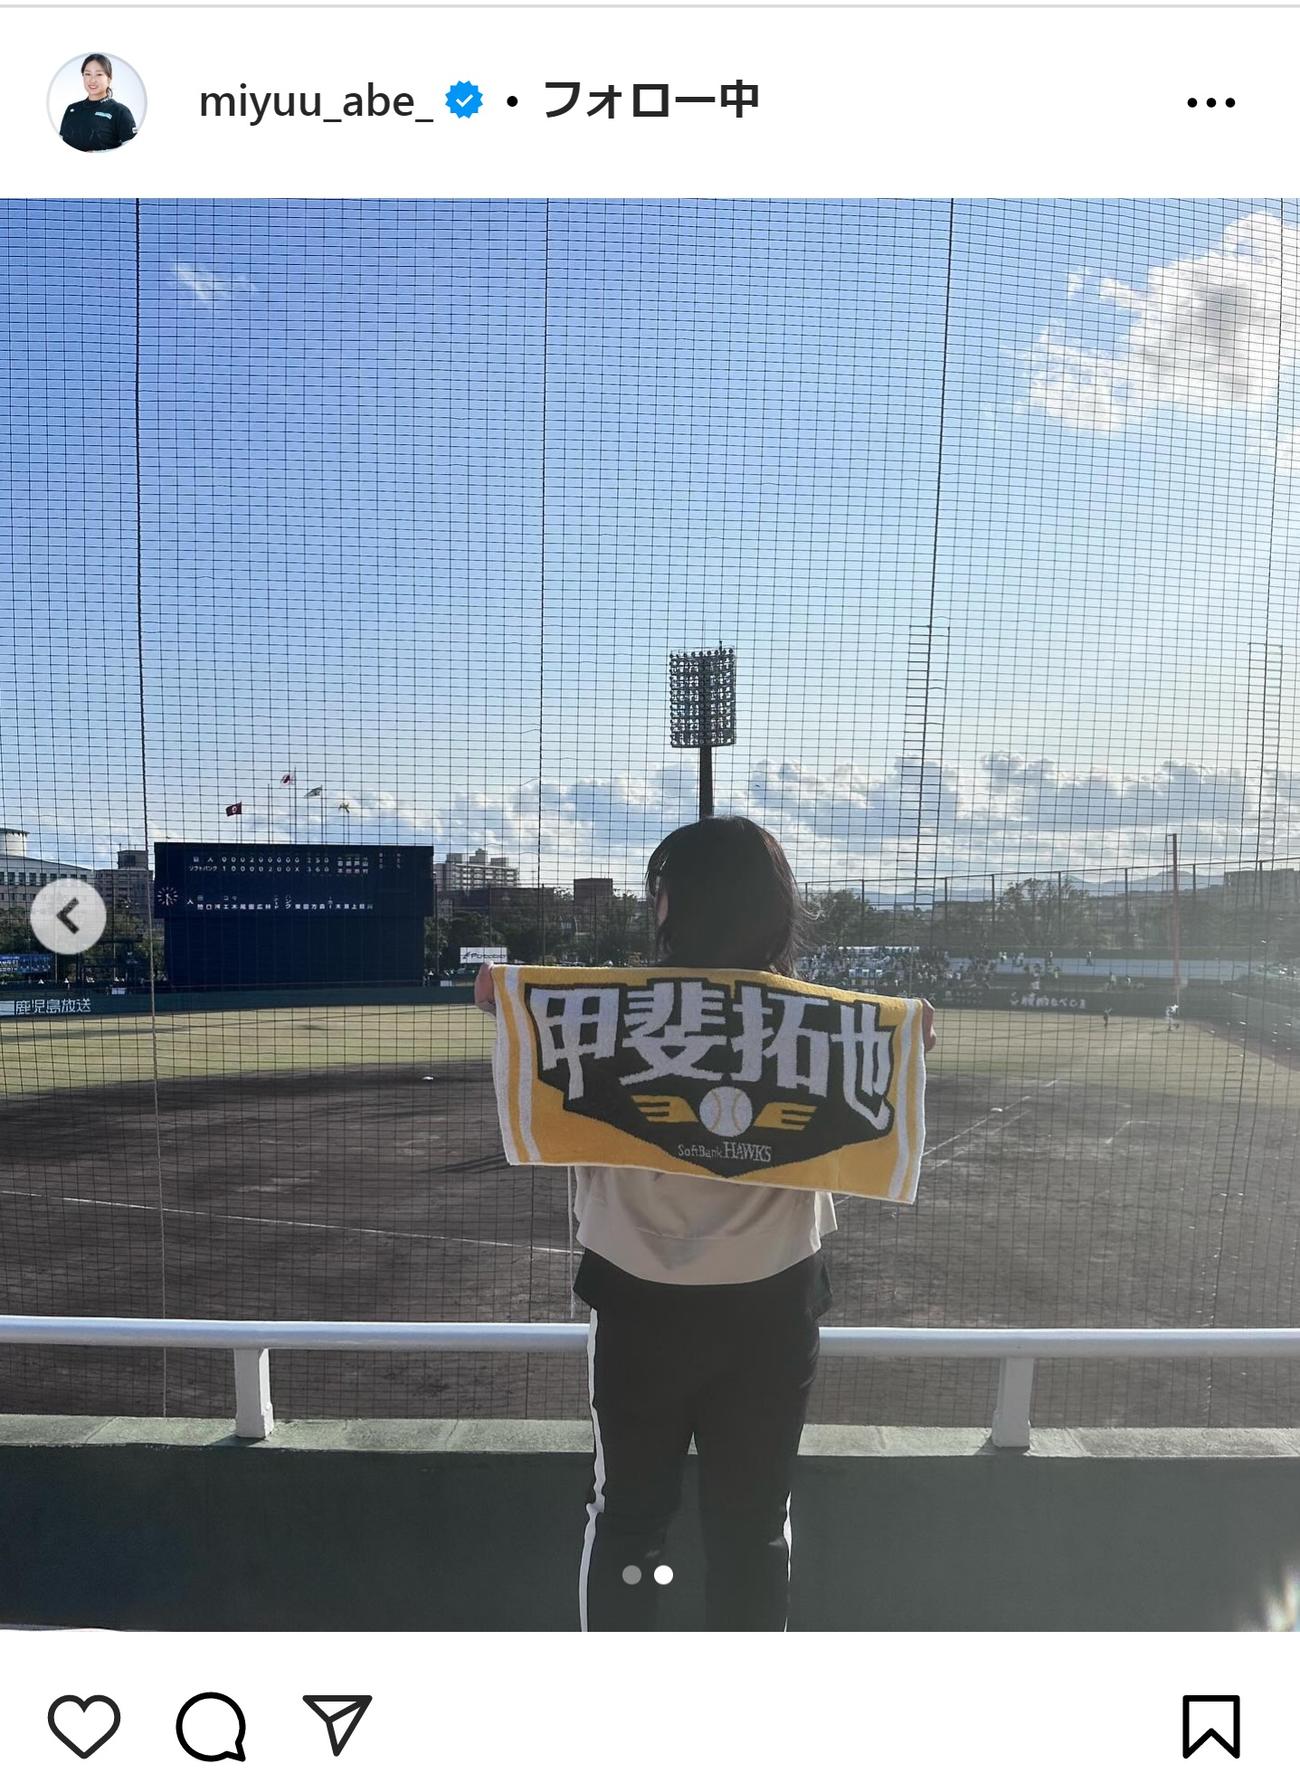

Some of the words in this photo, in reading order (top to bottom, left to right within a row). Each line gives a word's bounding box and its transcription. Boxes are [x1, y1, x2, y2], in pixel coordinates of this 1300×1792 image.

[15, 998, 92, 1015] 鹿児島放送
[529, 981, 892, 1131] 甲斐拓也
[678, 1143, 720, 1158] SoftBank
[722, 1141, 772, 1162] HAWKS
